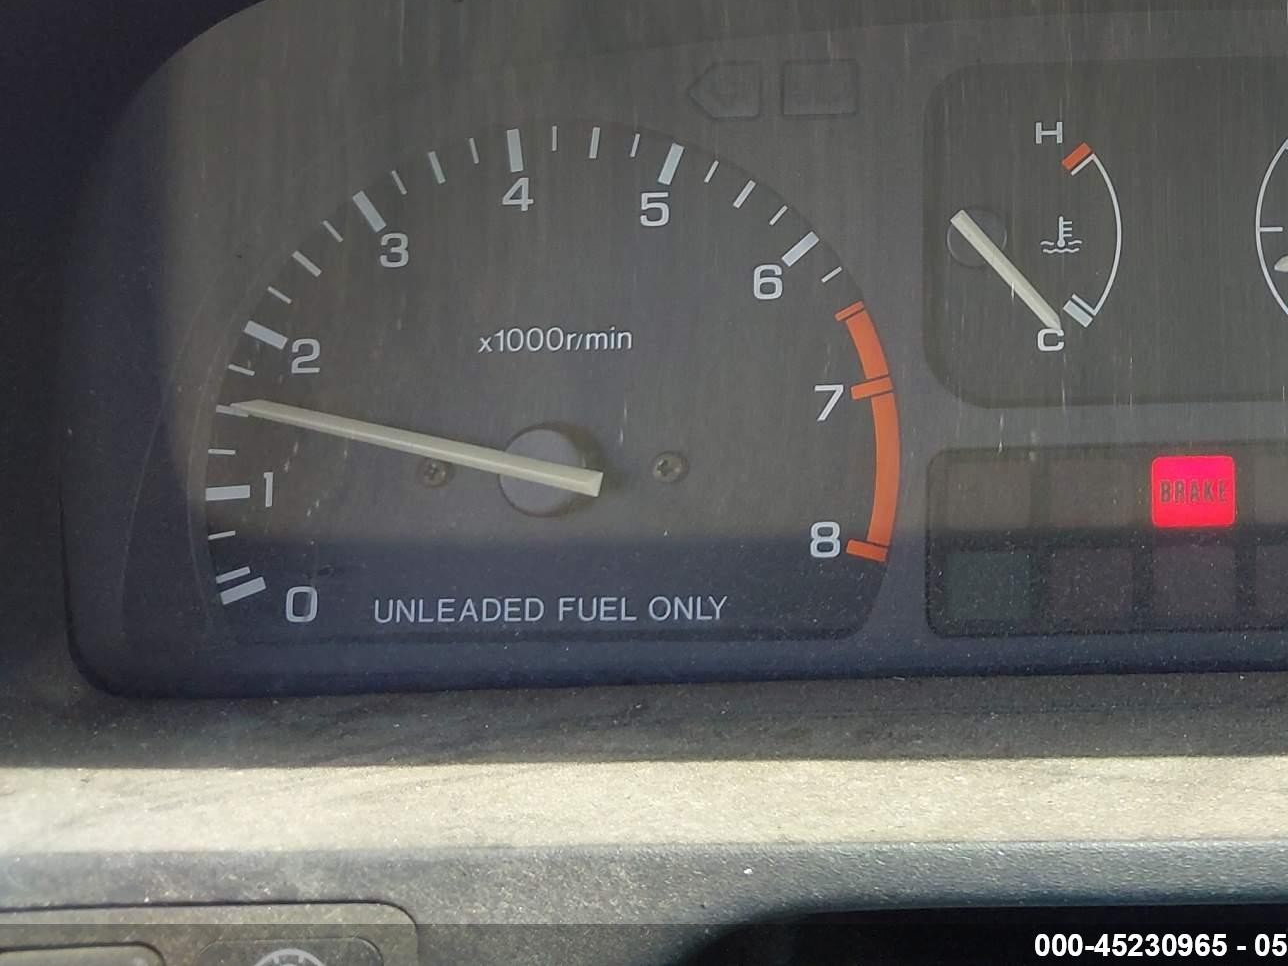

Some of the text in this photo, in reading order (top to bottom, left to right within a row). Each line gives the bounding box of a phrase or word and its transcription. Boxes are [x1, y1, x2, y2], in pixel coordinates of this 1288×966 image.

[1036, 122, 1063, 144] H
[502, 178, 534, 212] 4
[639, 192, 670, 226] 5
[379, 233, 409, 268] 3
[752, 265, 783, 300] 6
[291, 339, 320, 373] 2
[479, 327, 632, 353] x1000r/min
[1038, 329, 1065, 352] C
[814, 385, 844, 421] 7
[263, 472, 273, 507] 1
[1160, 479, 1227, 505] BRAKE
[810, 522, 841, 558] 8
[285, 586, 318, 622] 0
[374, 595, 728, 623] UNLEADED FUEL ONLY
